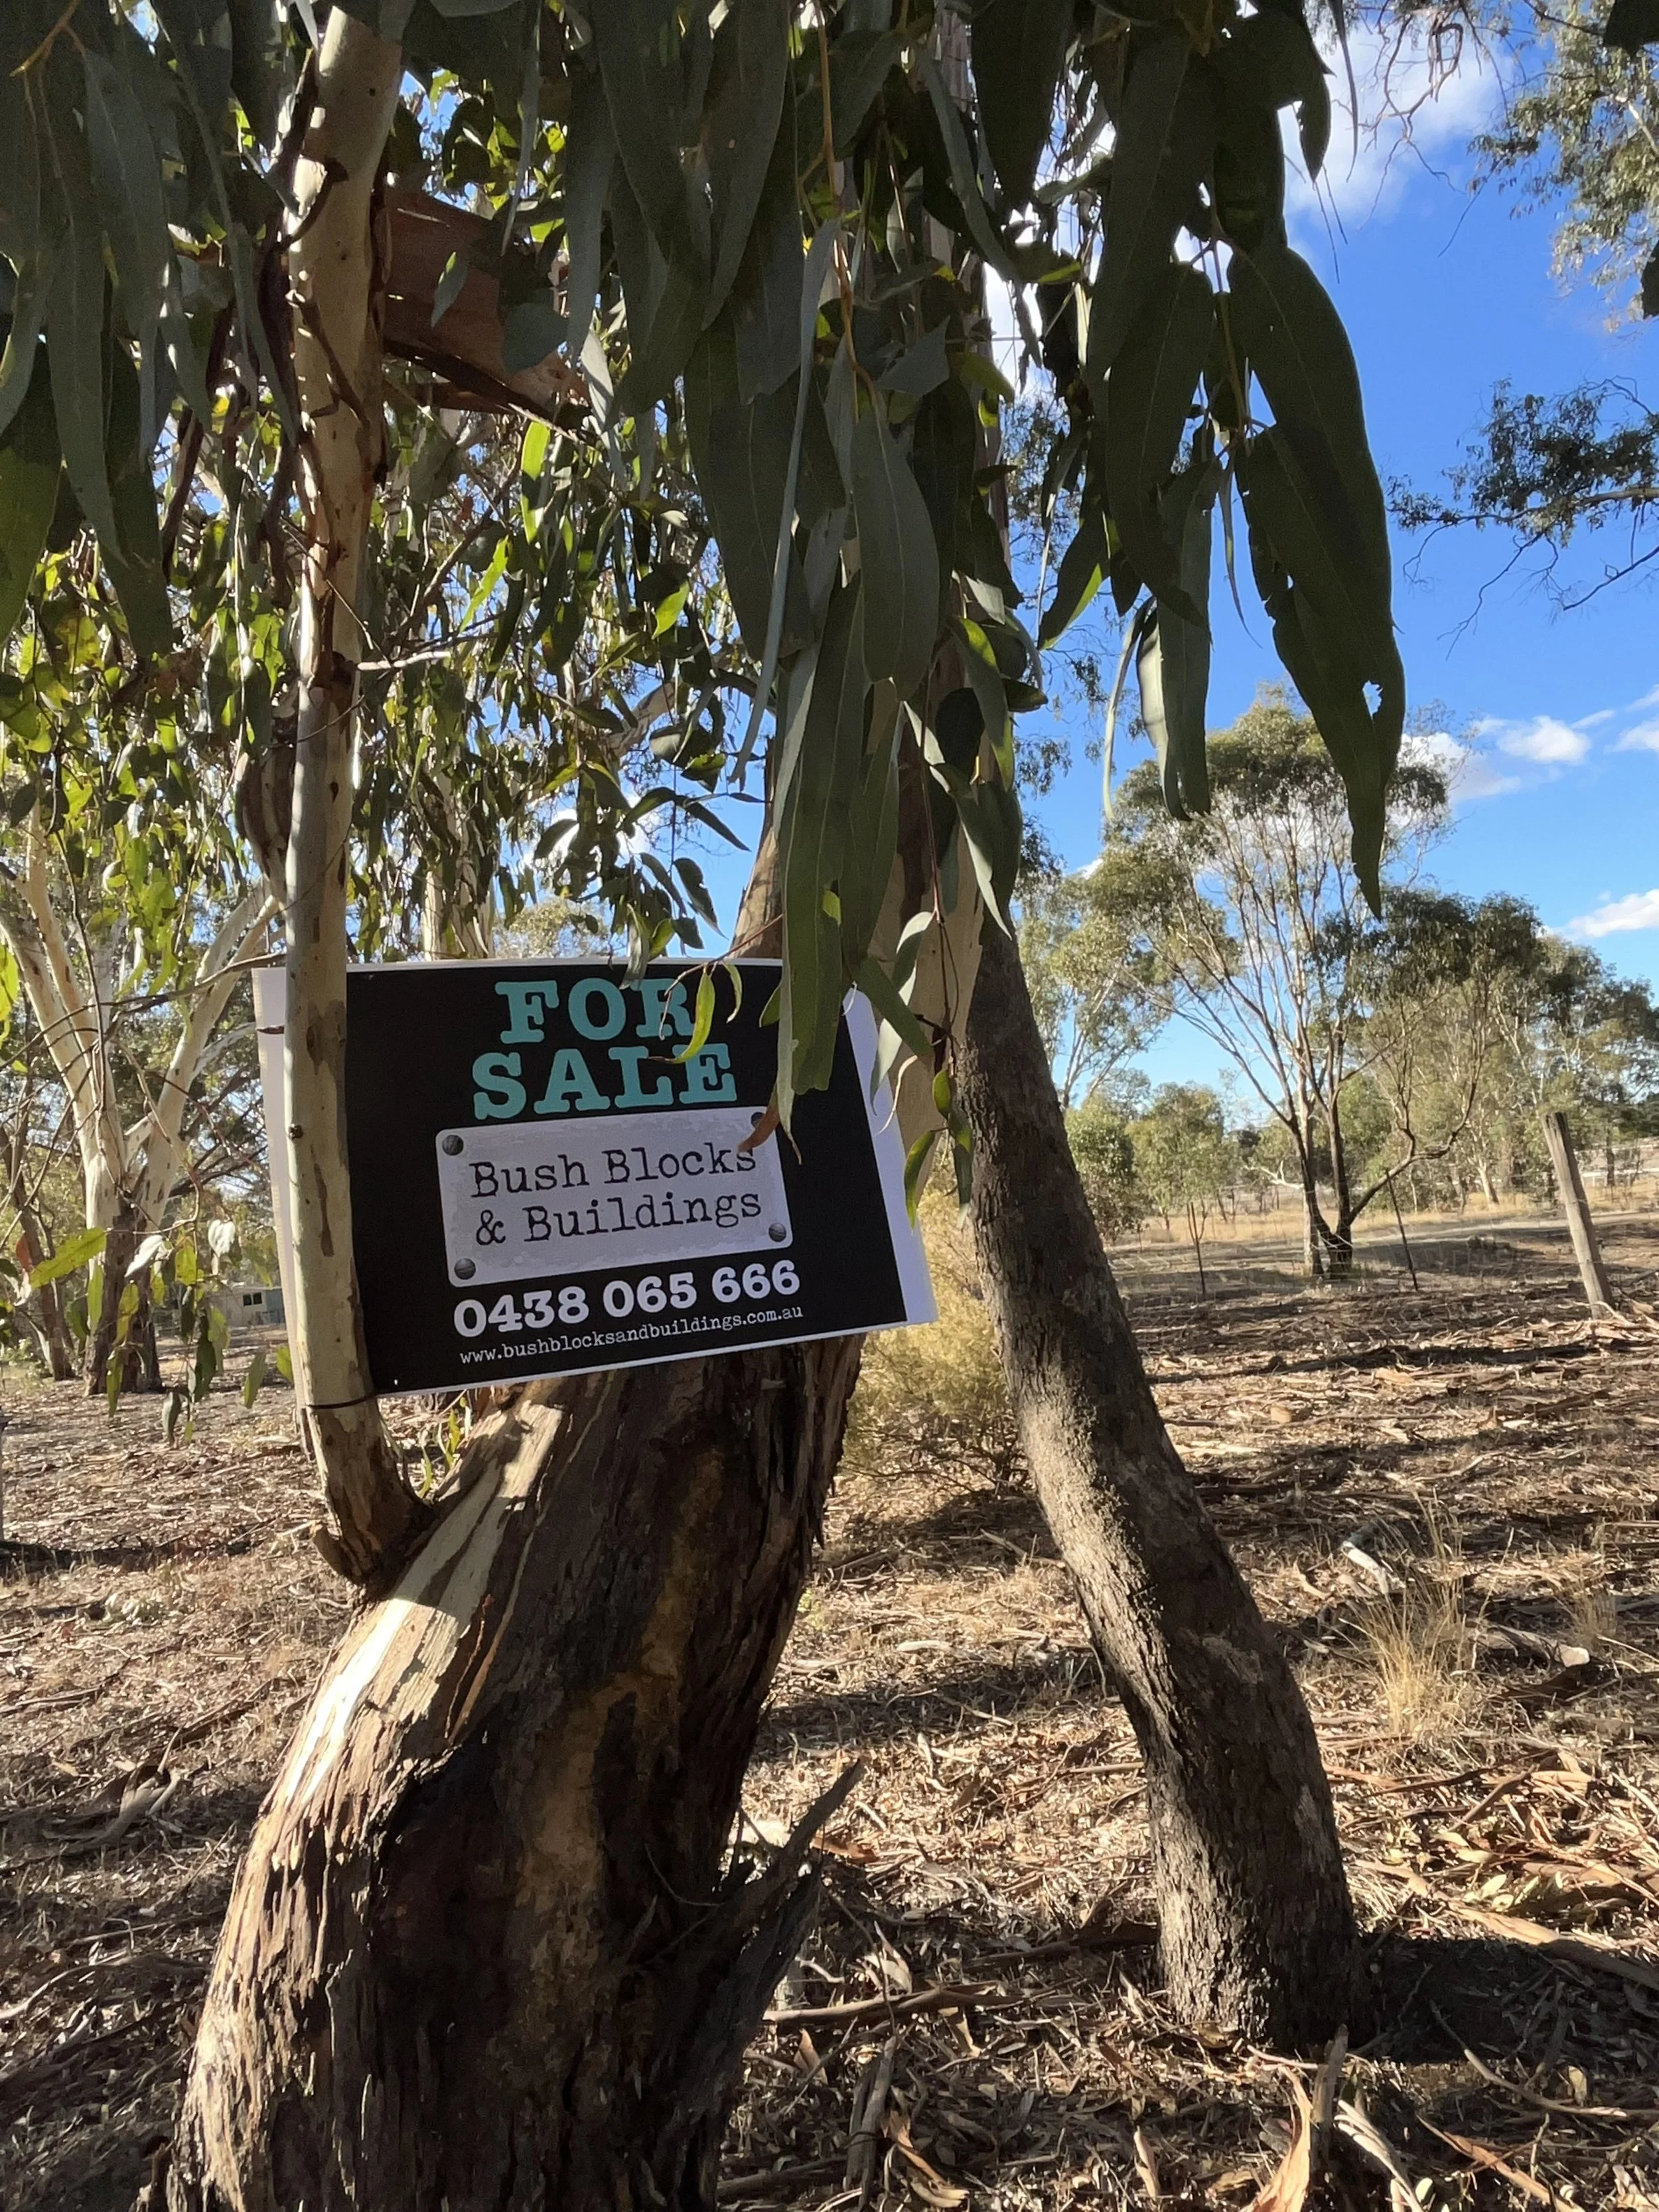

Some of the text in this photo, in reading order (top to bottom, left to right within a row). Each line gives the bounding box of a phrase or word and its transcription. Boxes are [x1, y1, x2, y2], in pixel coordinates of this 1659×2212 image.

[494, 977, 695, 1044] FOR
[472, 1043, 738, 1120] SALE
[470, 1142, 757, 1199] Bush Blocks
[476, 1191, 762, 1246] & Buildings
[454, 1260, 801, 1338] 0438 065 666
[459, 1305, 804, 1365] www.bushblocksandbuildings.com.au
